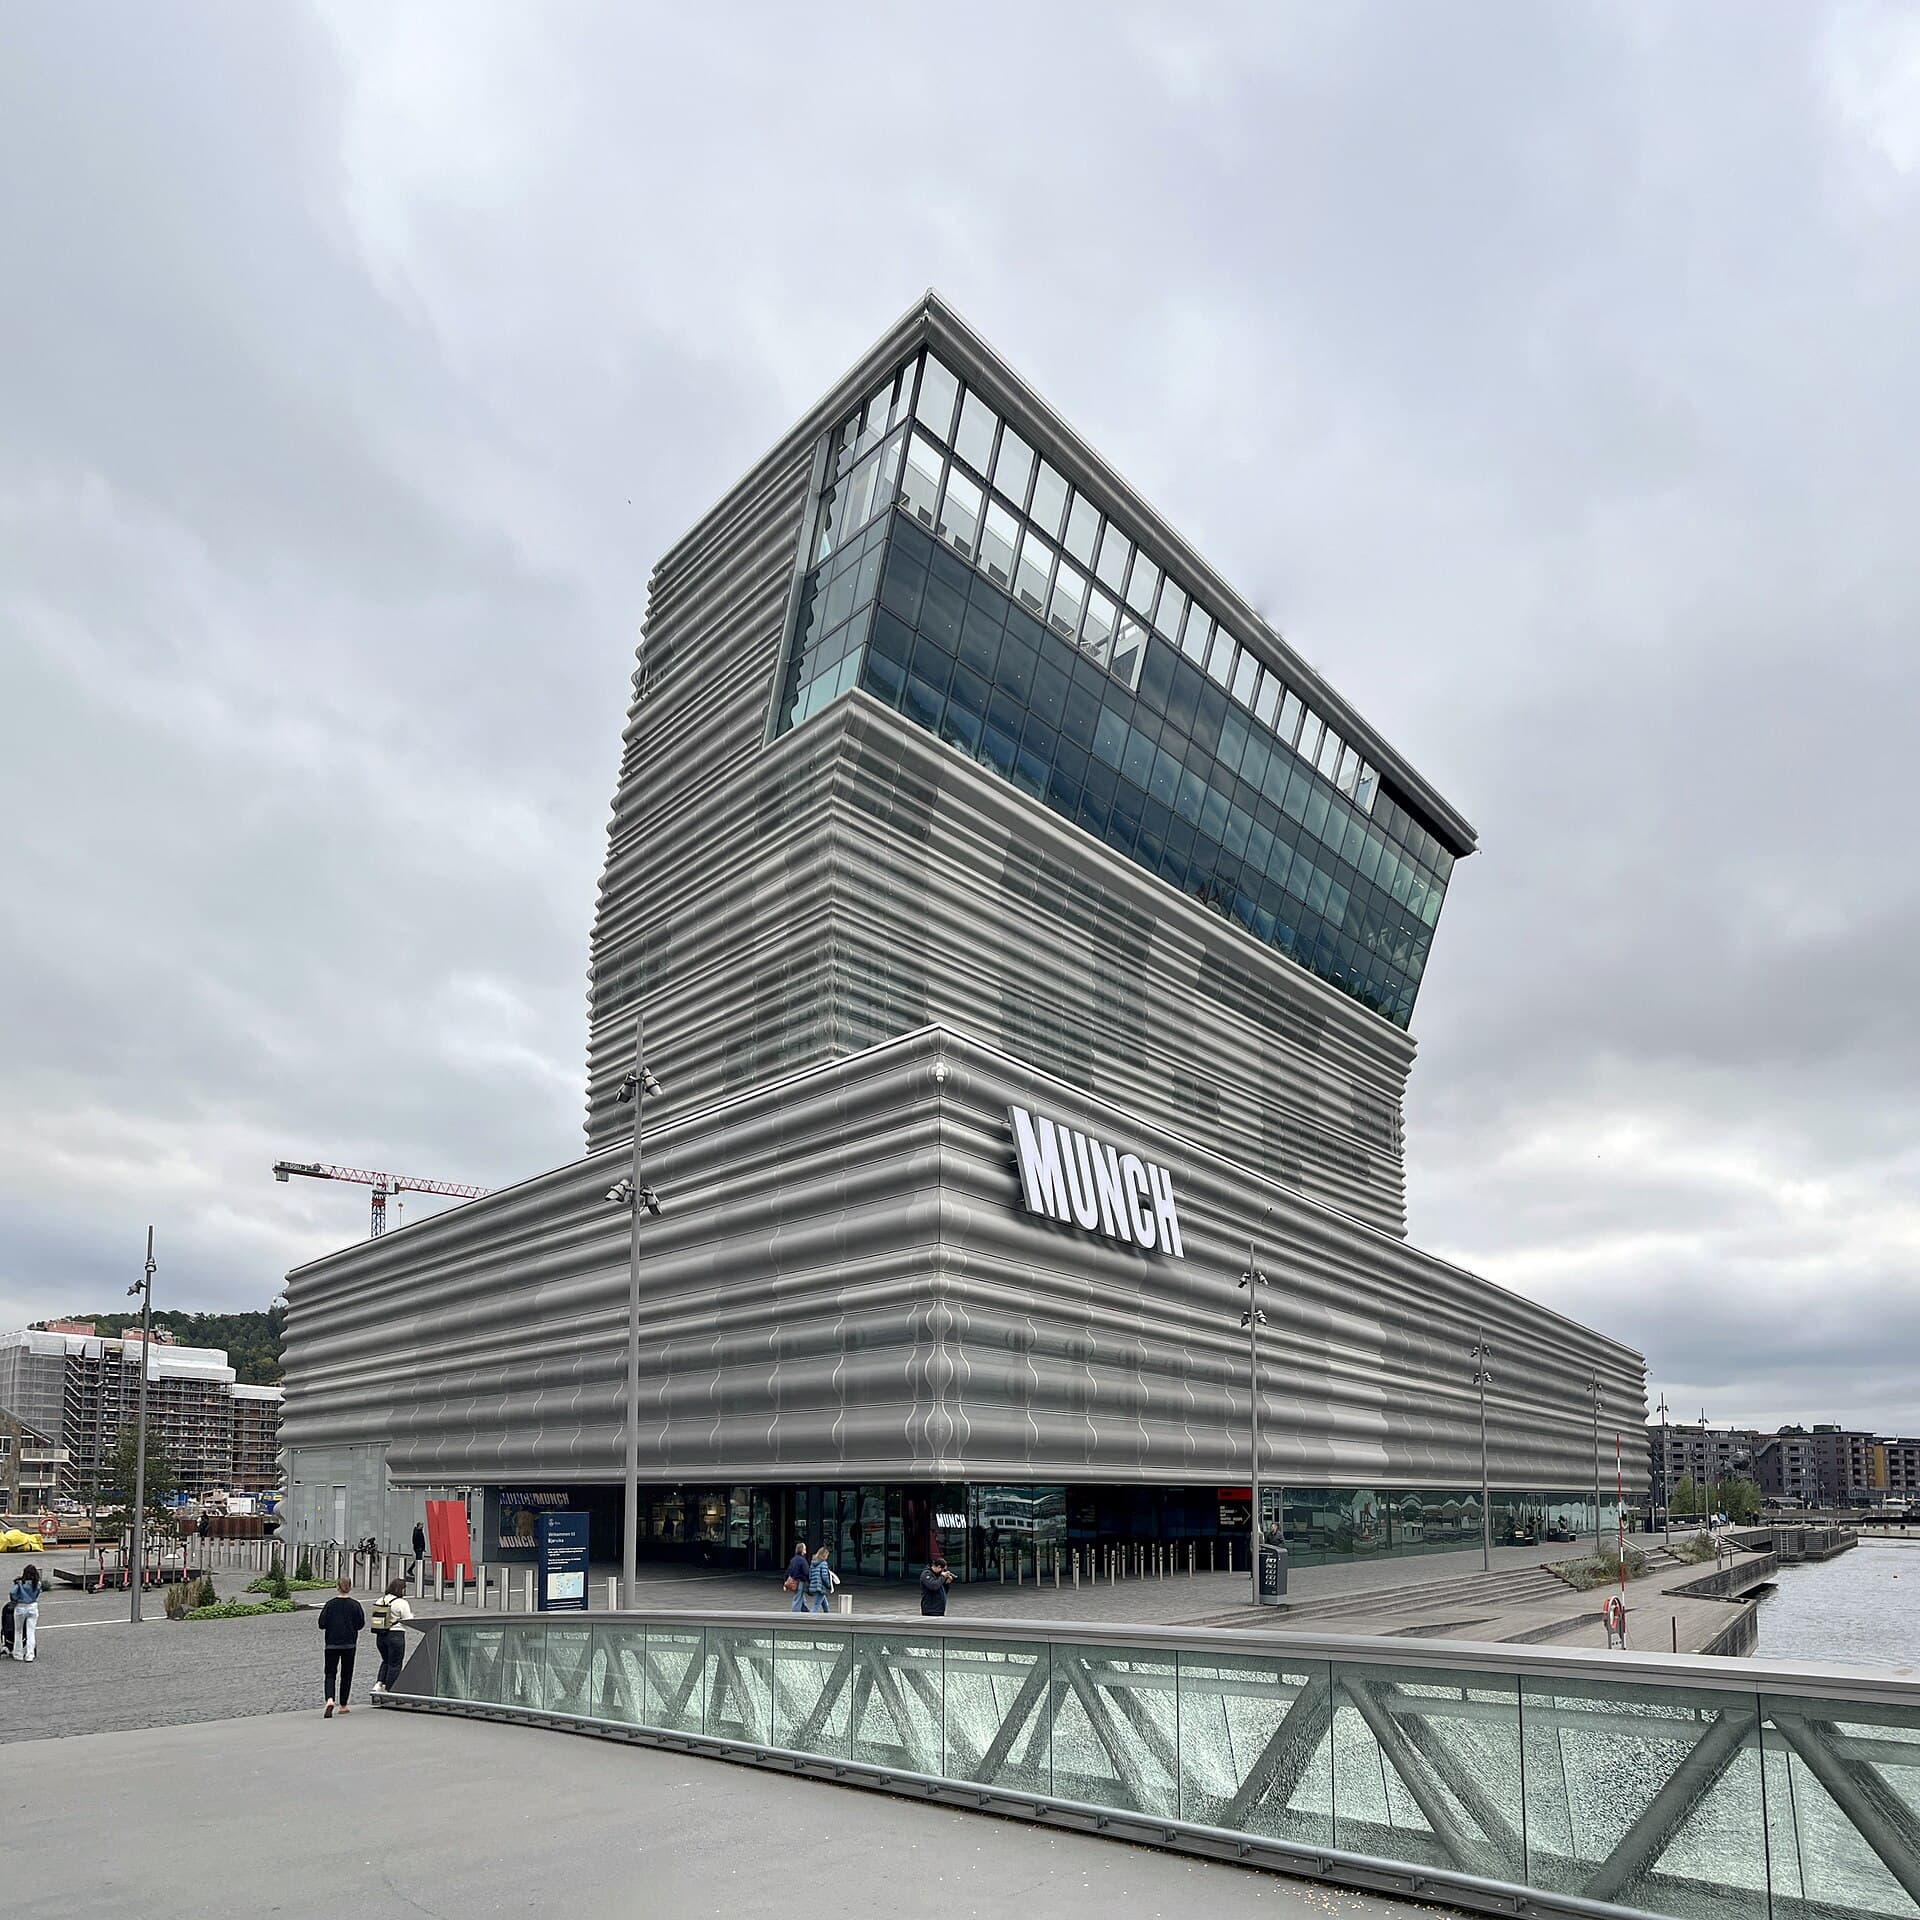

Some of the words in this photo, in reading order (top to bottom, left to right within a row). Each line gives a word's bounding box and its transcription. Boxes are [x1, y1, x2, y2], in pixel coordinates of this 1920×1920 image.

[1007, 1105, 1184, 1258] MUNCH
[935, 1513, 967, 1529] MUNCH
[499, 1535, 536, 1548] MUNCH
